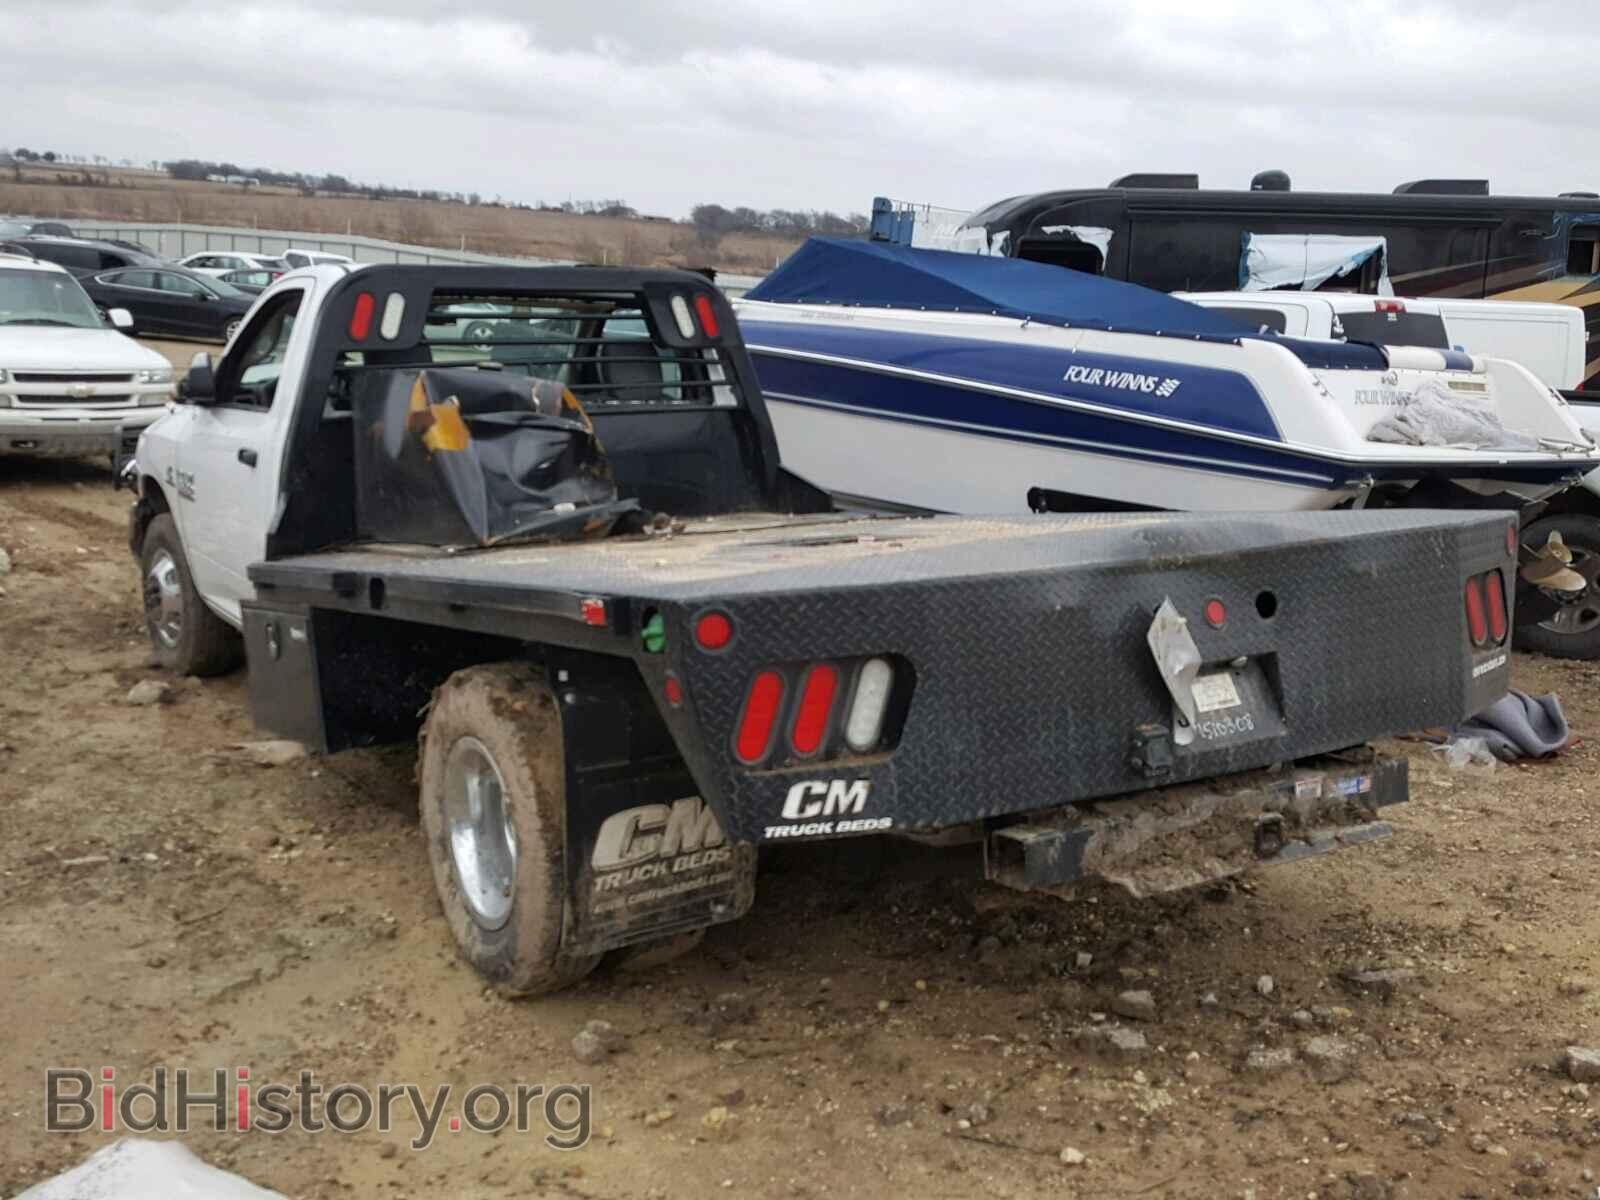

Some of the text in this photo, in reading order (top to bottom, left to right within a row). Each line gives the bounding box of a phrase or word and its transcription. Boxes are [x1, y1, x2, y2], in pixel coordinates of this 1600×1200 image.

[1063, 365, 1160, 393] FOUR WINNS
[781, 779, 870, 819] CM
[592, 796, 725, 872] CM
[764, 816, 893, 839] TRUCK BEDS
[594, 860, 669, 893] TRUCK
[672, 847, 732, 874] BEDS
